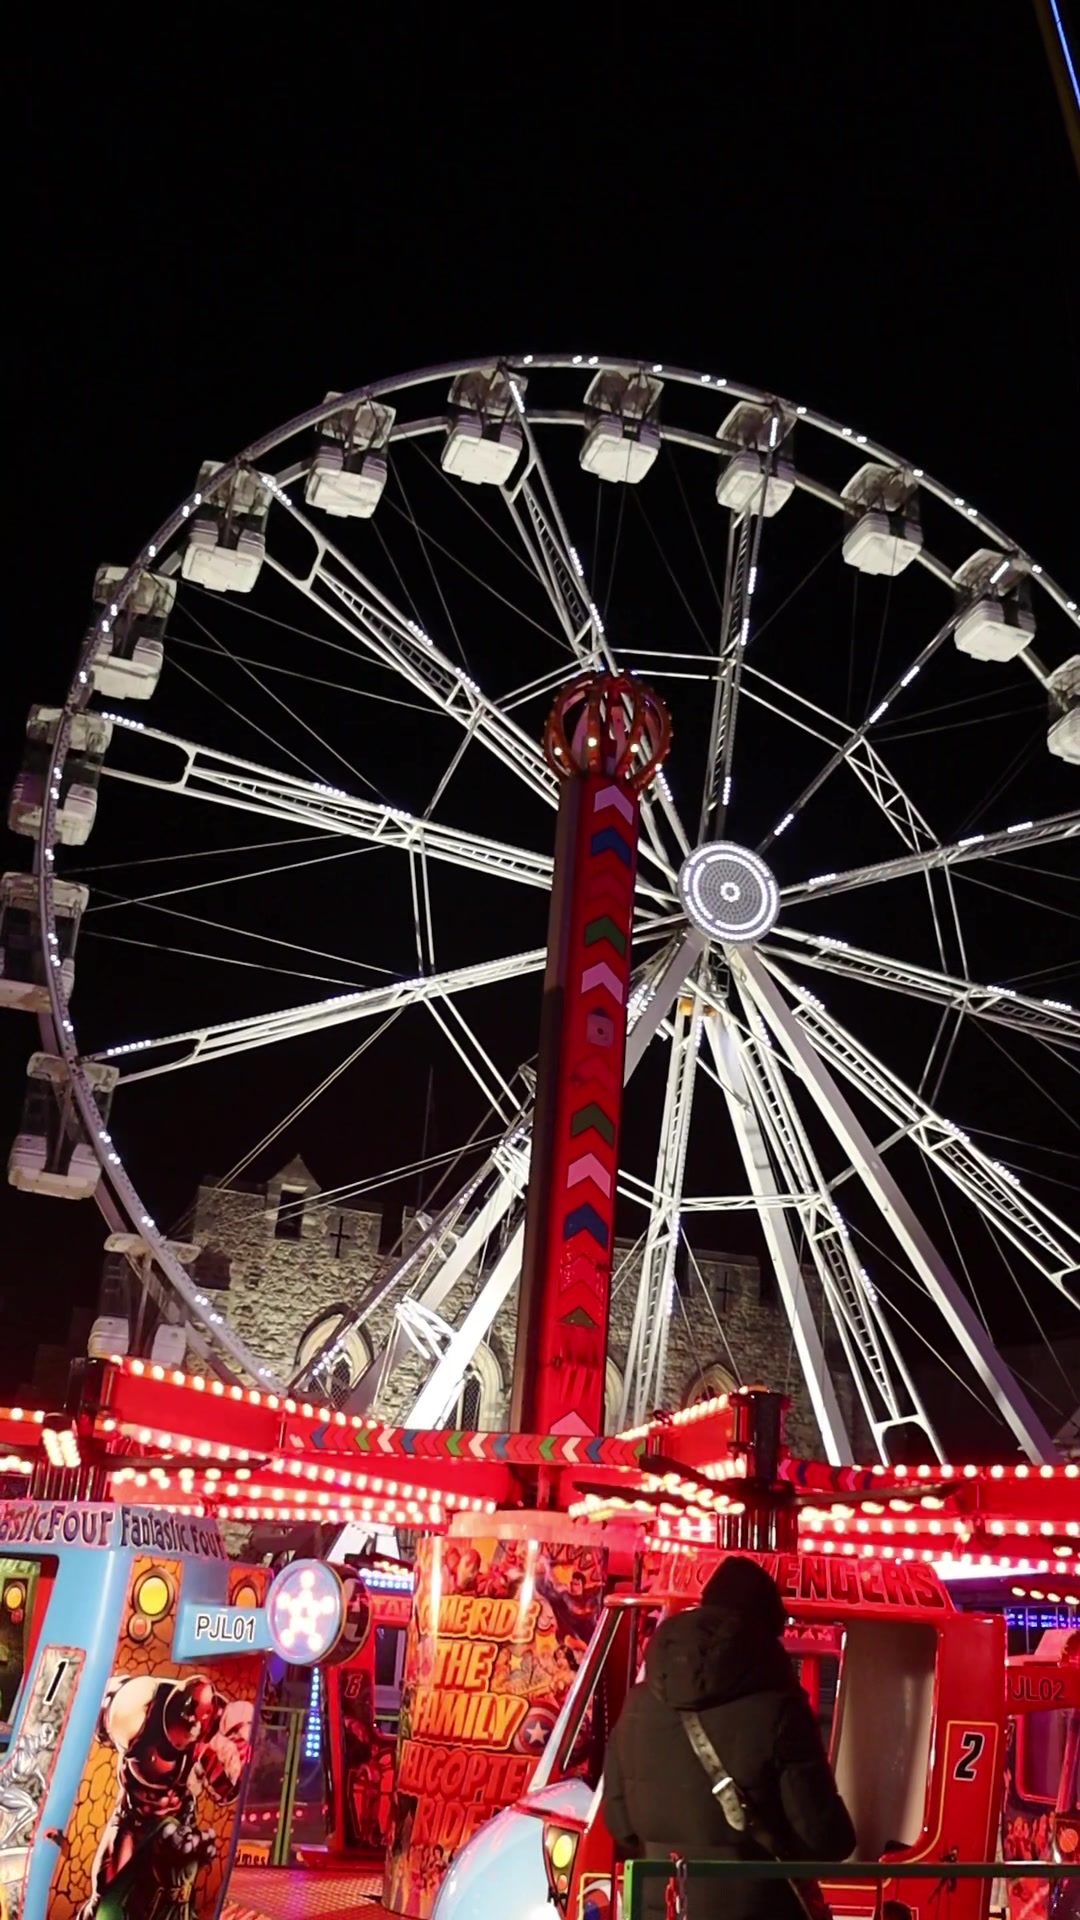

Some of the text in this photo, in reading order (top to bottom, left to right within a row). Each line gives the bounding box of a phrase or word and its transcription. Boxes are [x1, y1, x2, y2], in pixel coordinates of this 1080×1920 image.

[195, 1614, 255, 1643] PJL01
[44, 1658, 68, 1705] 1
[434, 1643, 496, 1692] THE
[1007, 1675, 1066, 1701] JL02
[412, 1691, 525, 1748] FAMILY
[954, 1733, 985, 1781] 2
